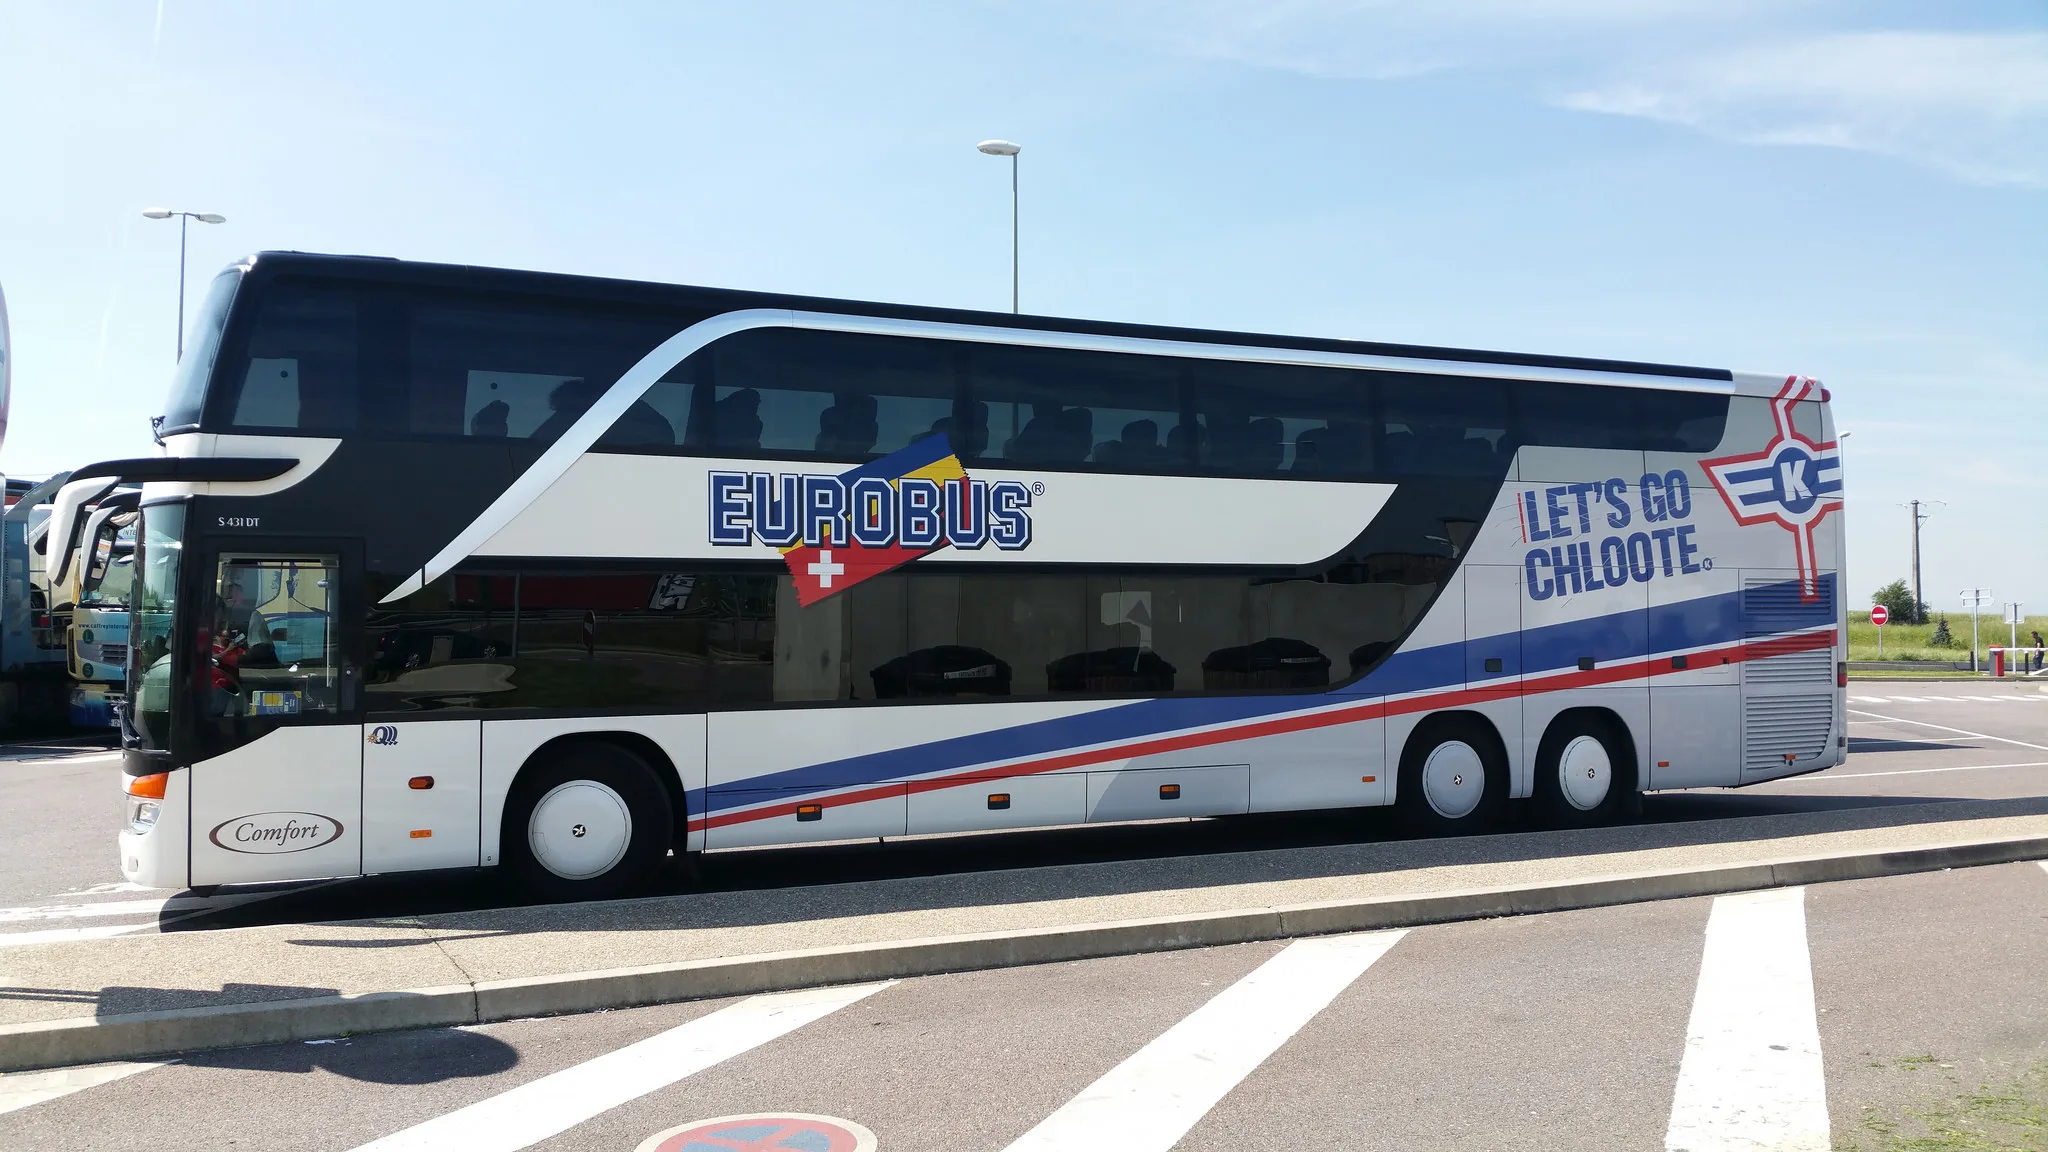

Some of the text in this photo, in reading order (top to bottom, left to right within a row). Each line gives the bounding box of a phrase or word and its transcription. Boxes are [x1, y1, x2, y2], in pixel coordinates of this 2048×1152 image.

[1780, 459, 1814, 501] K
[218, 517, 261, 527] S 431 DT
[1525, 469, 1692, 542] LET'S GO
[235, 819, 319, 846] Comfort
